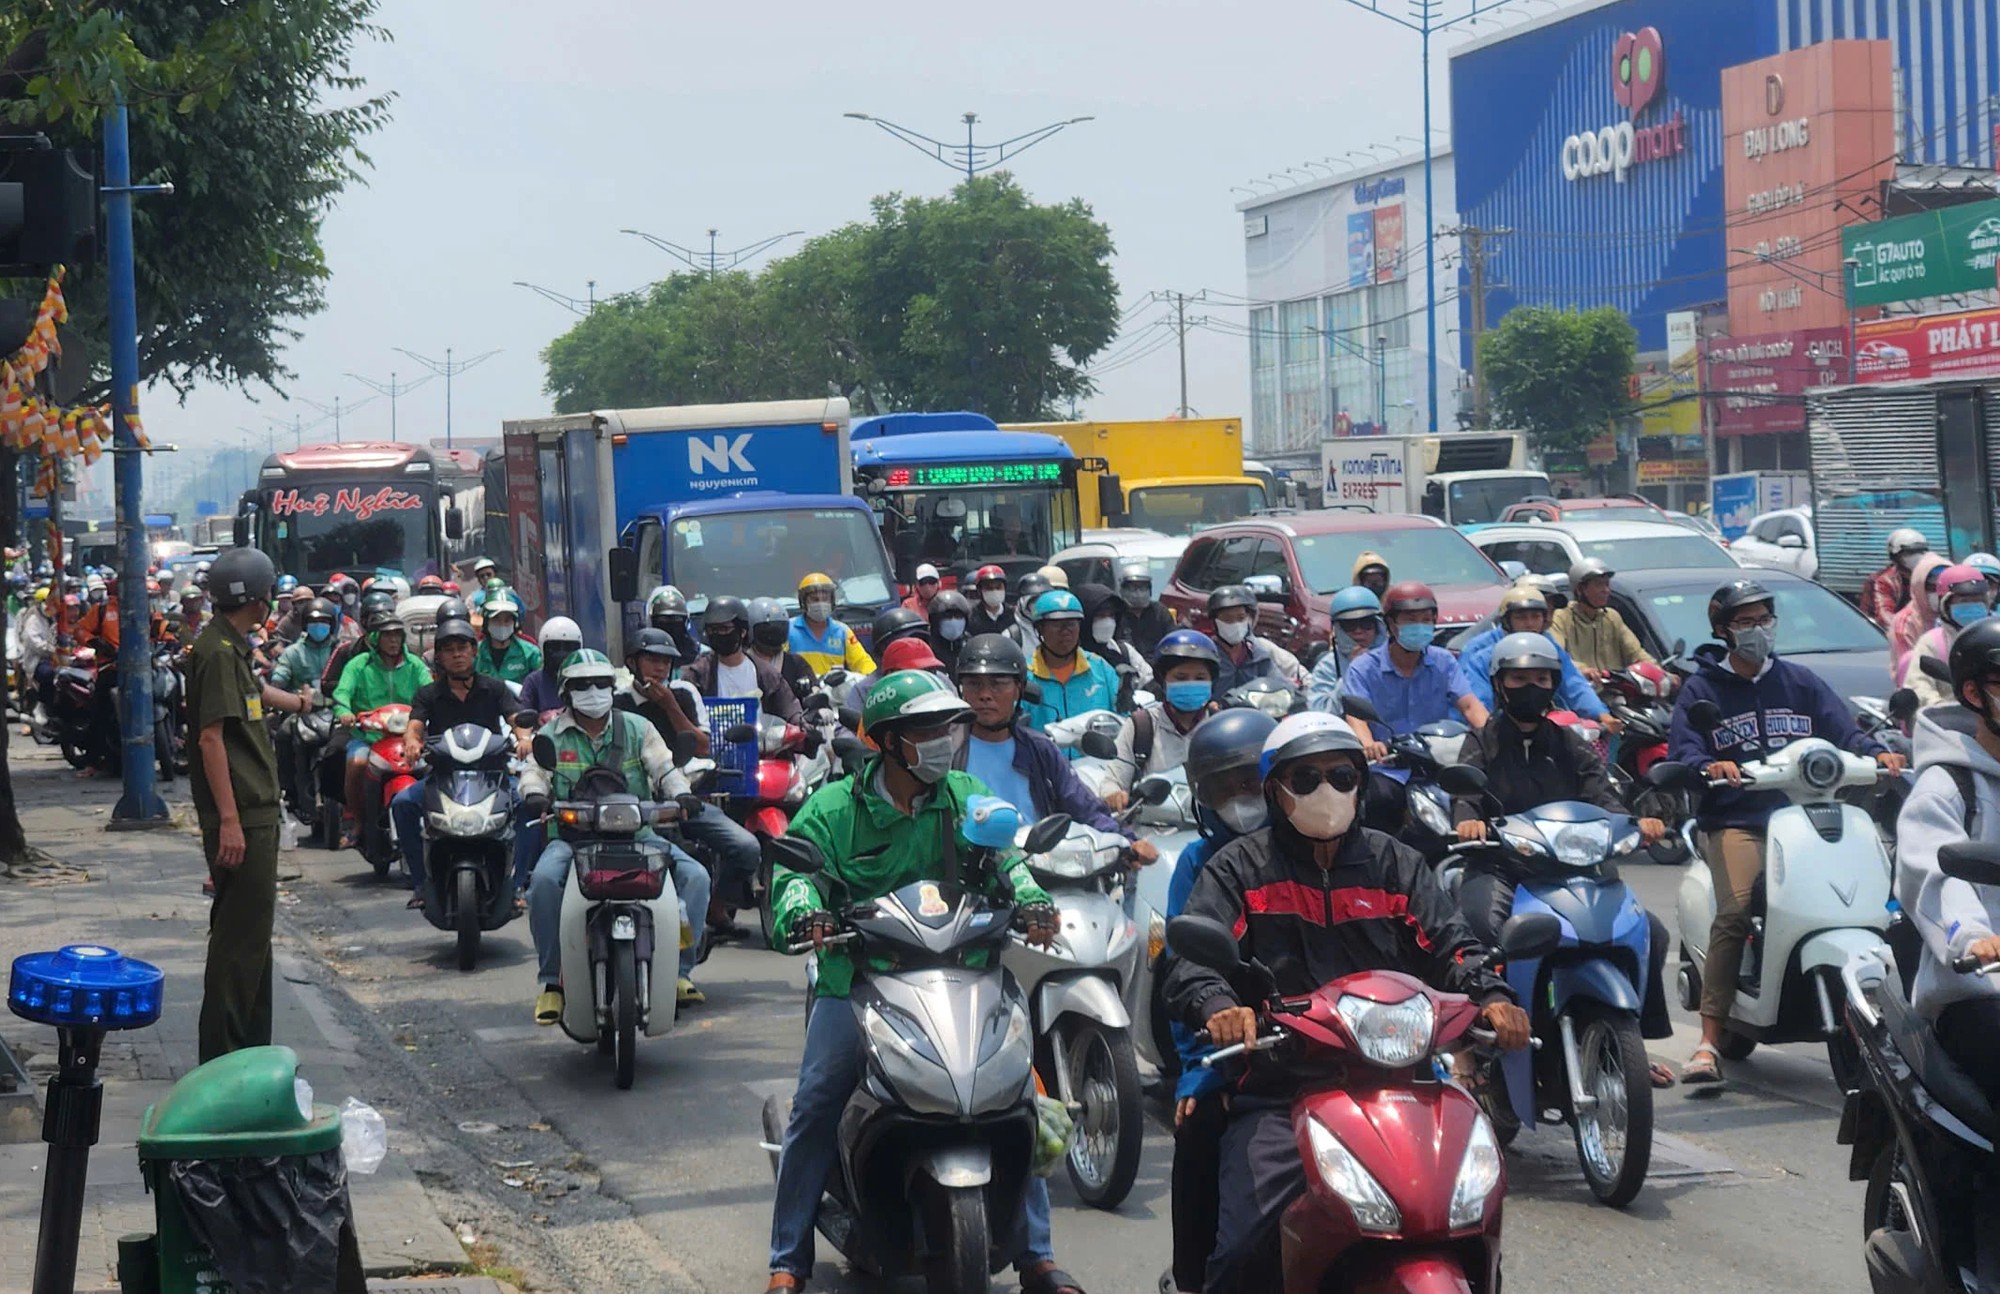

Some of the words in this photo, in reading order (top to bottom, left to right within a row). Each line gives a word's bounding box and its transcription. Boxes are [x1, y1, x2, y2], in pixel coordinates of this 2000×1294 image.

[1771, 117, 1808, 153] LONG
[1877, 239, 1924, 264] G7AUTO
[1927, 318, 1985, 354] PHÁT
[687, 433, 756, 474] NK
[272, 489, 330, 516] Huệ
[333, 486, 423, 521] Nghĩa
[1342, 482, 1378, 499] EXPRESS
[866, 686, 897, 709] Grab
